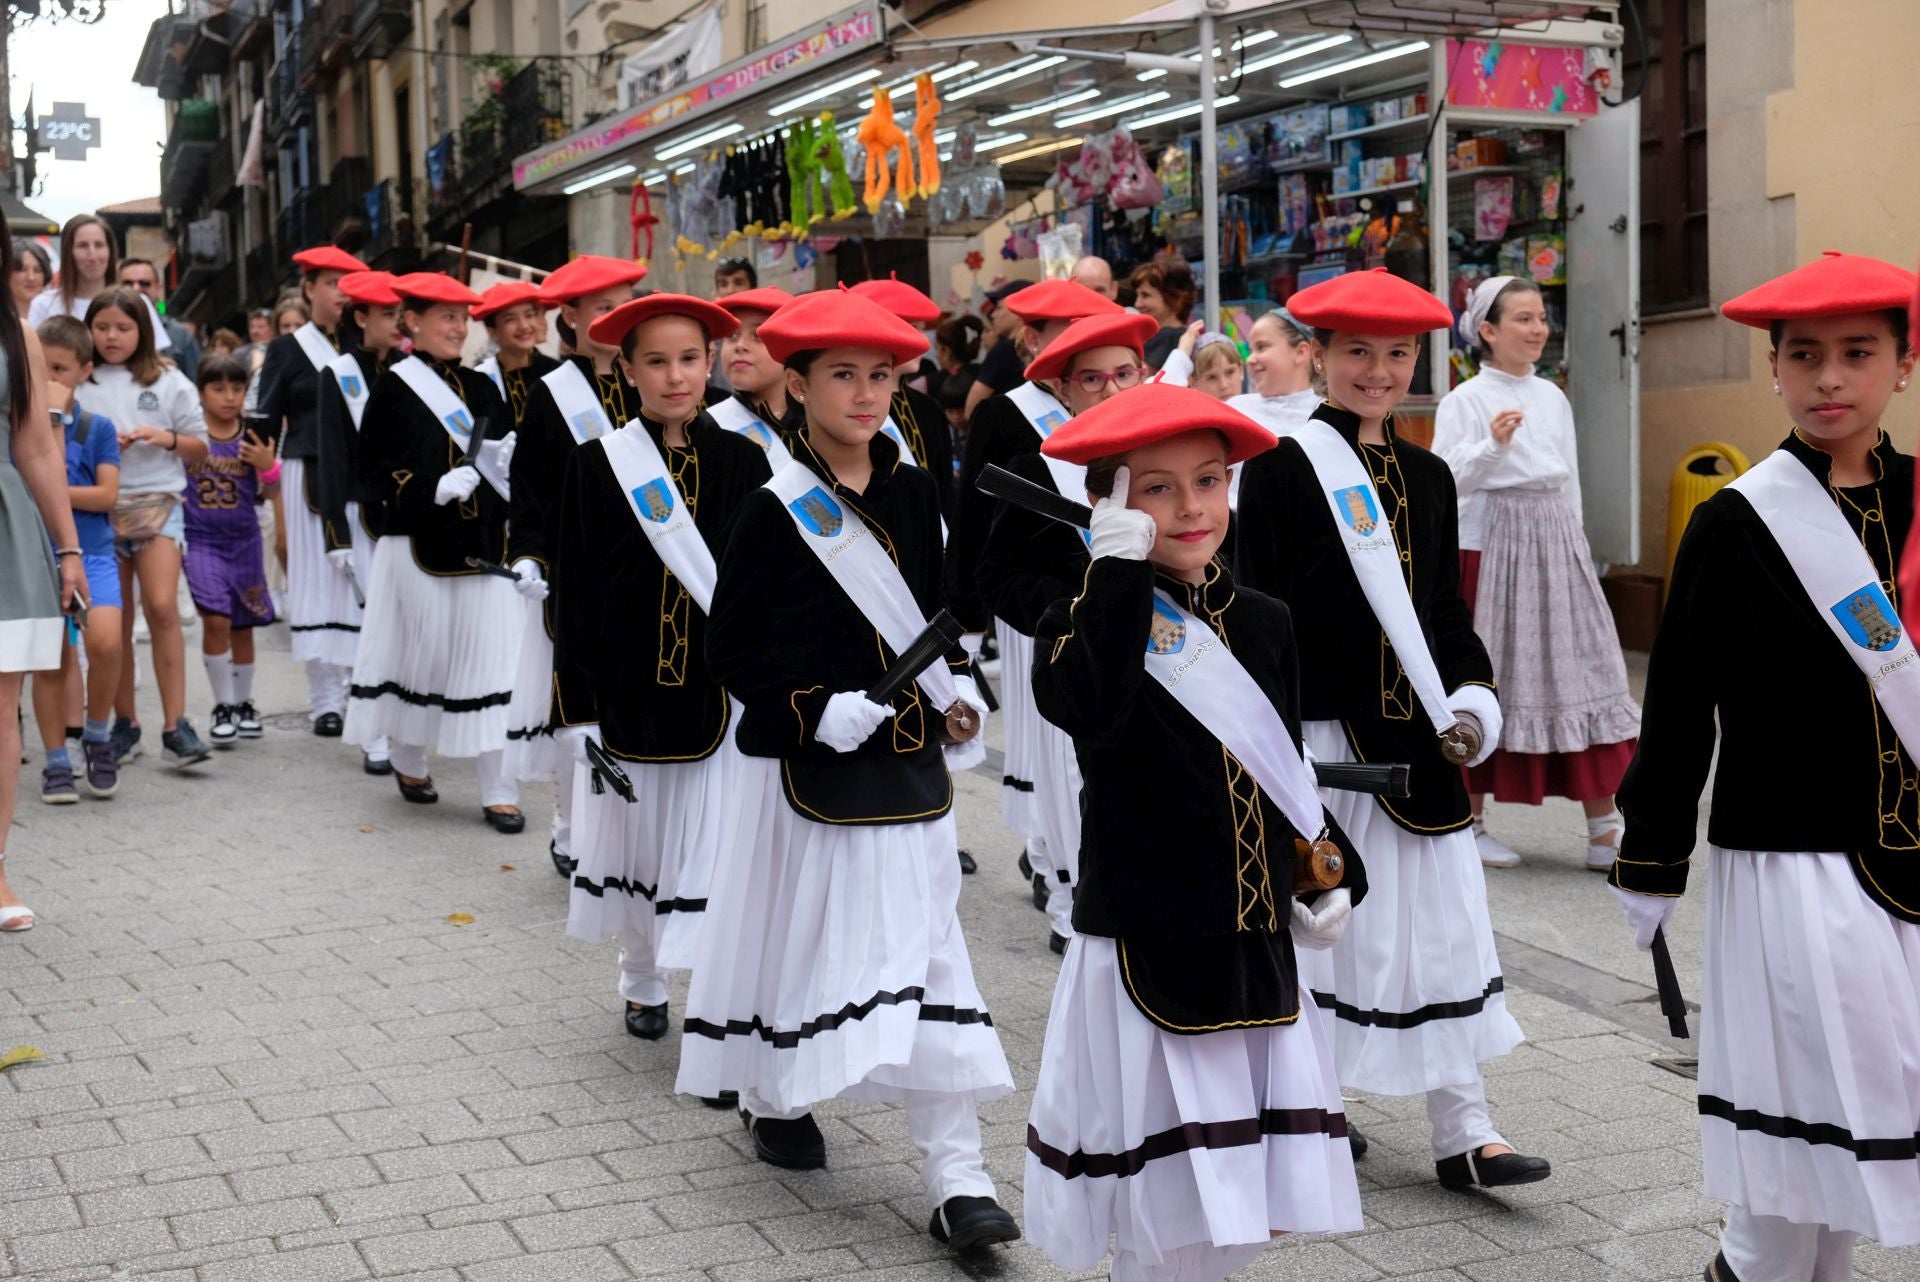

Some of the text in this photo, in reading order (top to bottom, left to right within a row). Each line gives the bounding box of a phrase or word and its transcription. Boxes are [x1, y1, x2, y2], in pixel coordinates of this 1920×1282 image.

[735, 44, 804, 88] DULCES
[808, 15, 869, 59] PATXI
[197, 477, 239, 509] 23
[834, 533, 856, 552] ORDIZIA
[1178, 648, 1203, 672] ORDIZIA
[1884, 652, 1915, 672] ORDIZIA
